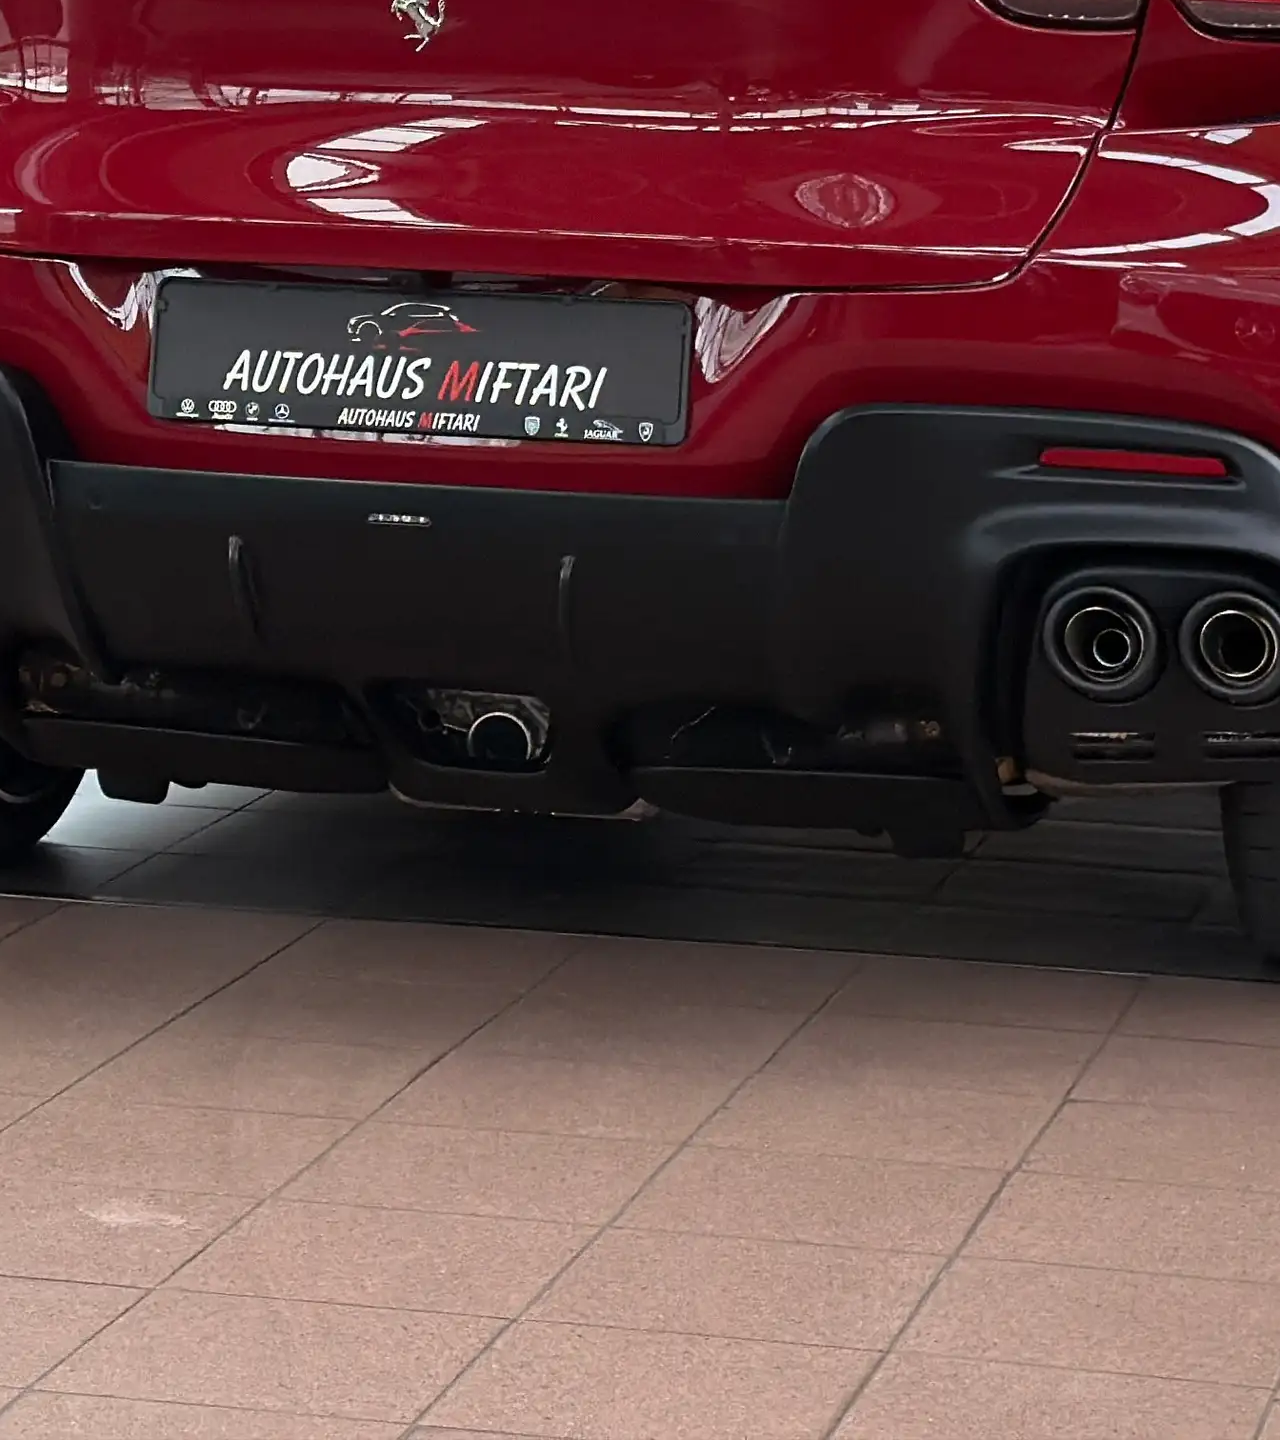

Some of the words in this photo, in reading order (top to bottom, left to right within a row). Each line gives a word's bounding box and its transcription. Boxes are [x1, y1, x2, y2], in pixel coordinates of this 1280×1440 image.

[223, 349, 431, 400] AUTOHAUS
[437, 360, 608, 411] MIFTARI
[337, 407, 415, 428] AUTOHAUS
[417, 411, 481, 432] MIFTARI
[583, 429, 618, 440] JAGUAR
